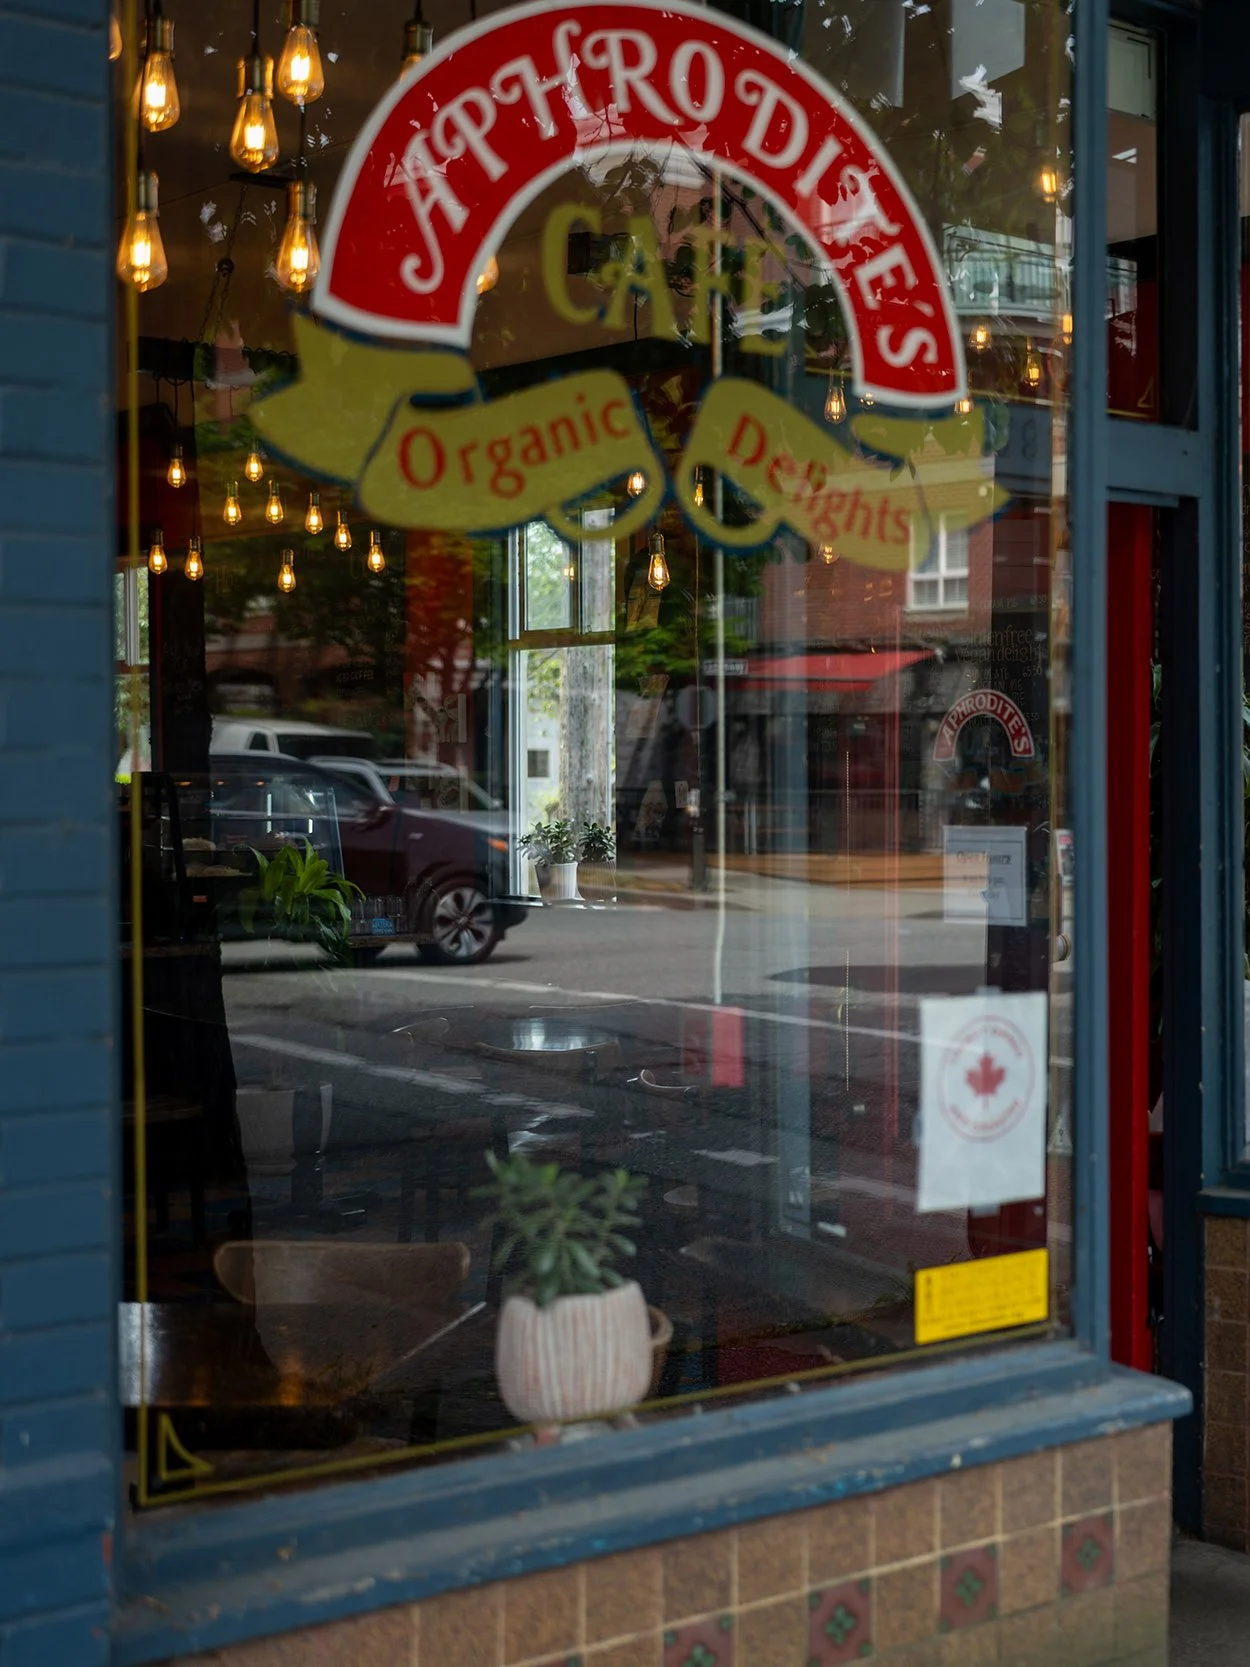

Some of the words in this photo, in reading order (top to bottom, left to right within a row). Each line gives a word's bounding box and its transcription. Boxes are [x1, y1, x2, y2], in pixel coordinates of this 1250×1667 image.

[400, 20, 939, 368] APHRODITE'S
[398, 393, 630, 499] Organic
[727, 412, 911, 546] Delights
[941, 694, 1029, 753] APHRODITE'S
